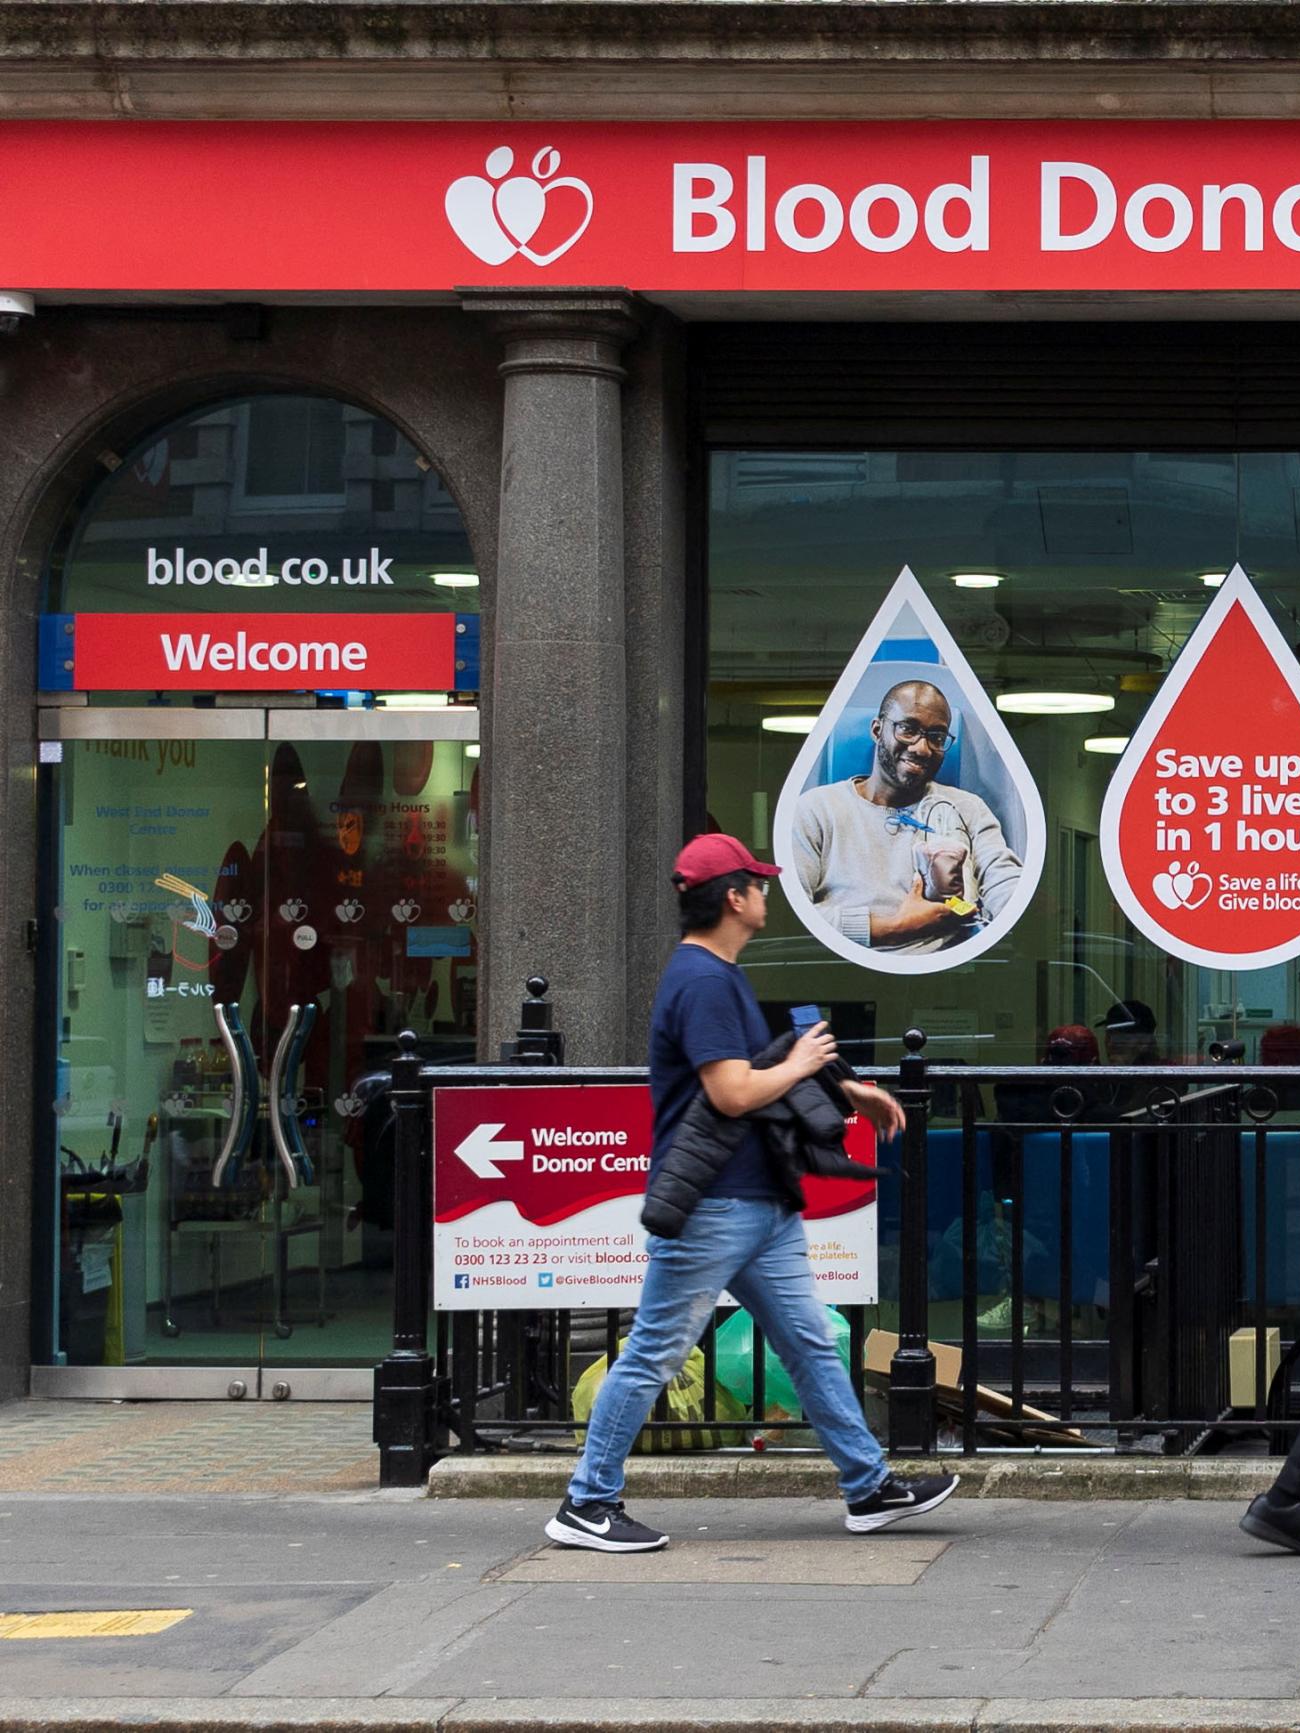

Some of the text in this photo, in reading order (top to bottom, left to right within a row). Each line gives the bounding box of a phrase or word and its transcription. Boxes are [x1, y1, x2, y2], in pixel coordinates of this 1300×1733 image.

[672, 155, 990, 253] Blood
[147, 547, 394, 586] blood.co.uk
[160, 631, 368, 671] Welcome
[1155, 749, 1243, 778] Save
[391, 802, 430, 813] Hours
[1154, 787, 1196, 816] to
[1207, 786, 1229, 816] 3
[1156, 821, 1191, 851] in
[1203, 822, 1221, 851] 1
[70, 864, 110, 877] When
[1219, 874, 1261, 891] Save
[1266, 878, 1276, 891] a
[82, 898, 105, 912] for
[1219, 893, 1259, 911] Give
[532, 1127, 628, 1147] Welcome
[532, 1155, 596, 1173] Donor
[455, 1235, 634, 1250] To book an appointment call
[454, 1254, 485, 1266] 0300
[489, 1254, 511, 1265] 123
[514, 1253, 529, 1265] 23
[532, 1253, 548, 1265] 23
[551, 1255, 564, 1264] or
[568, 1253, 591, 1264] visit
[820, 1251, 858, 1261] platelets
[472, 1276, 527, 1286] NHSBlood
[556, 1274, 643, 1285] @GiveBloodNHS
